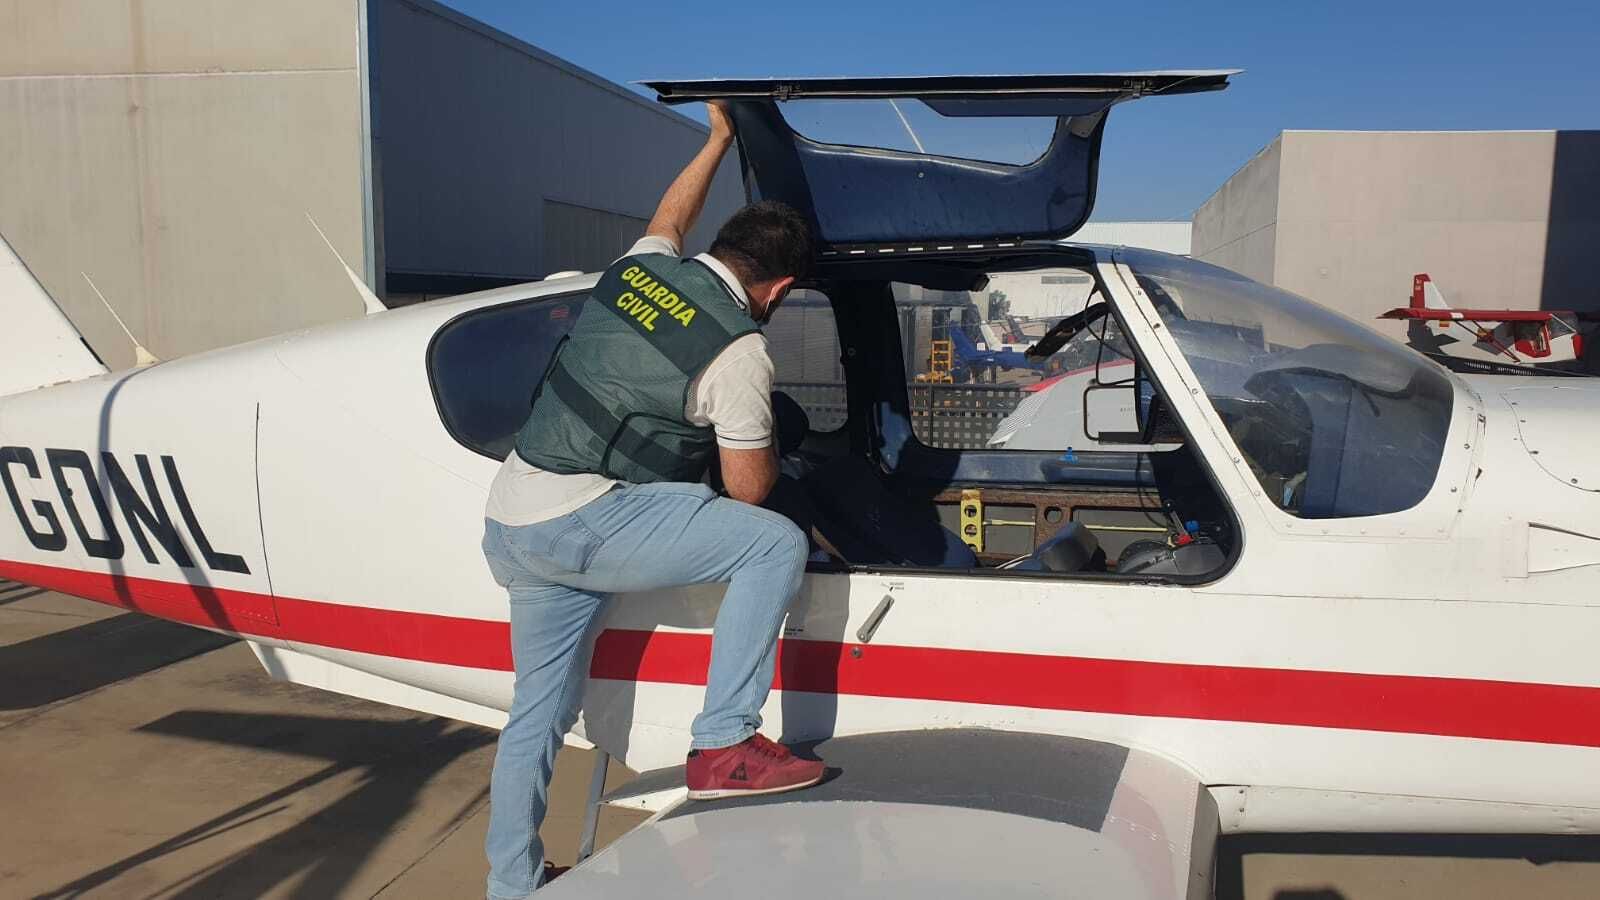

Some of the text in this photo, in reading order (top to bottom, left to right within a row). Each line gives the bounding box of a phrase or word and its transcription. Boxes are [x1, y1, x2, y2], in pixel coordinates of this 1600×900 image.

[616, 292, 660, 332] CIVIL
[621, 266, 697, 327] GUARDIA
[0, 446, 251, 575] GDNL
